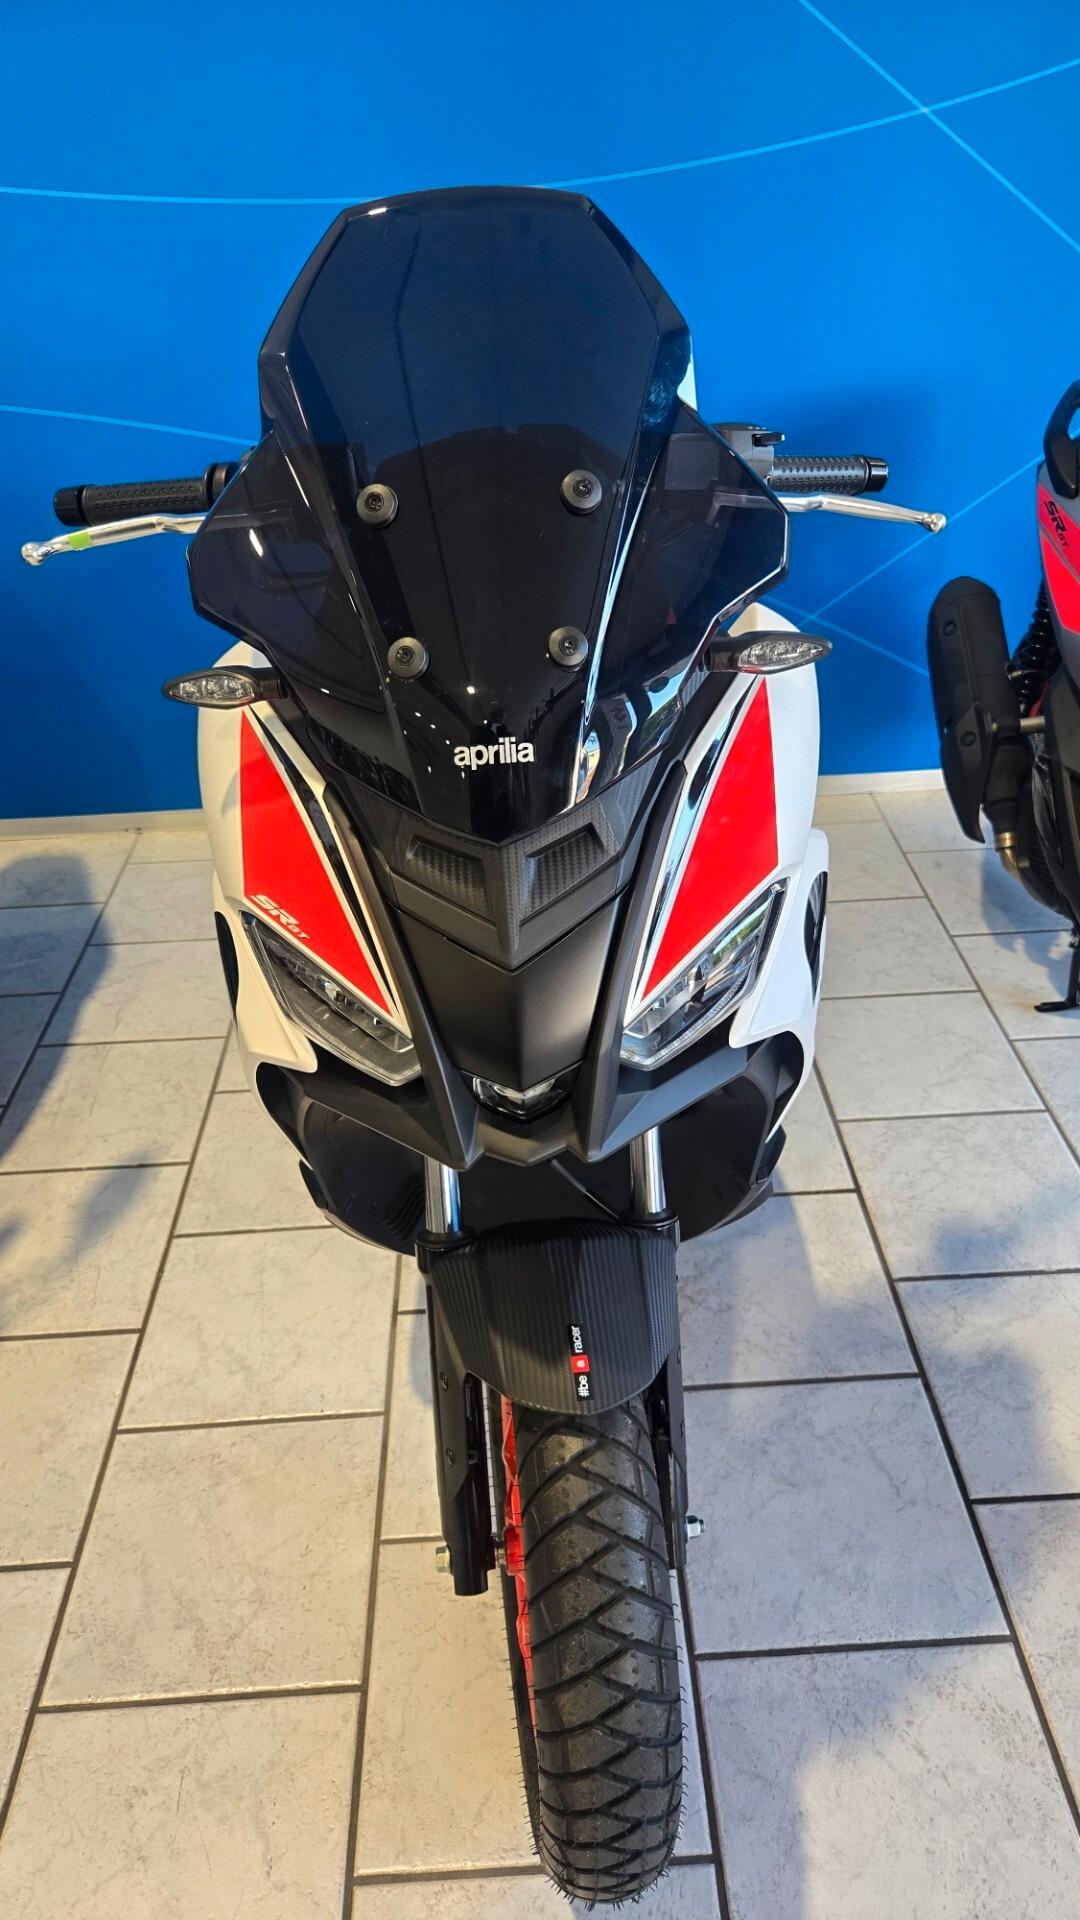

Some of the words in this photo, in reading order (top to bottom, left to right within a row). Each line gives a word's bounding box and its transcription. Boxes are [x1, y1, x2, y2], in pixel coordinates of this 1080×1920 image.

[1044, 500, 1067, 533] SR
[453, 736, 535, 771] aprilia
[248, 894, 300, 926] SR
[570, 1325, 584, 1354] racer
[577, 1375, 590, 1398] #be
